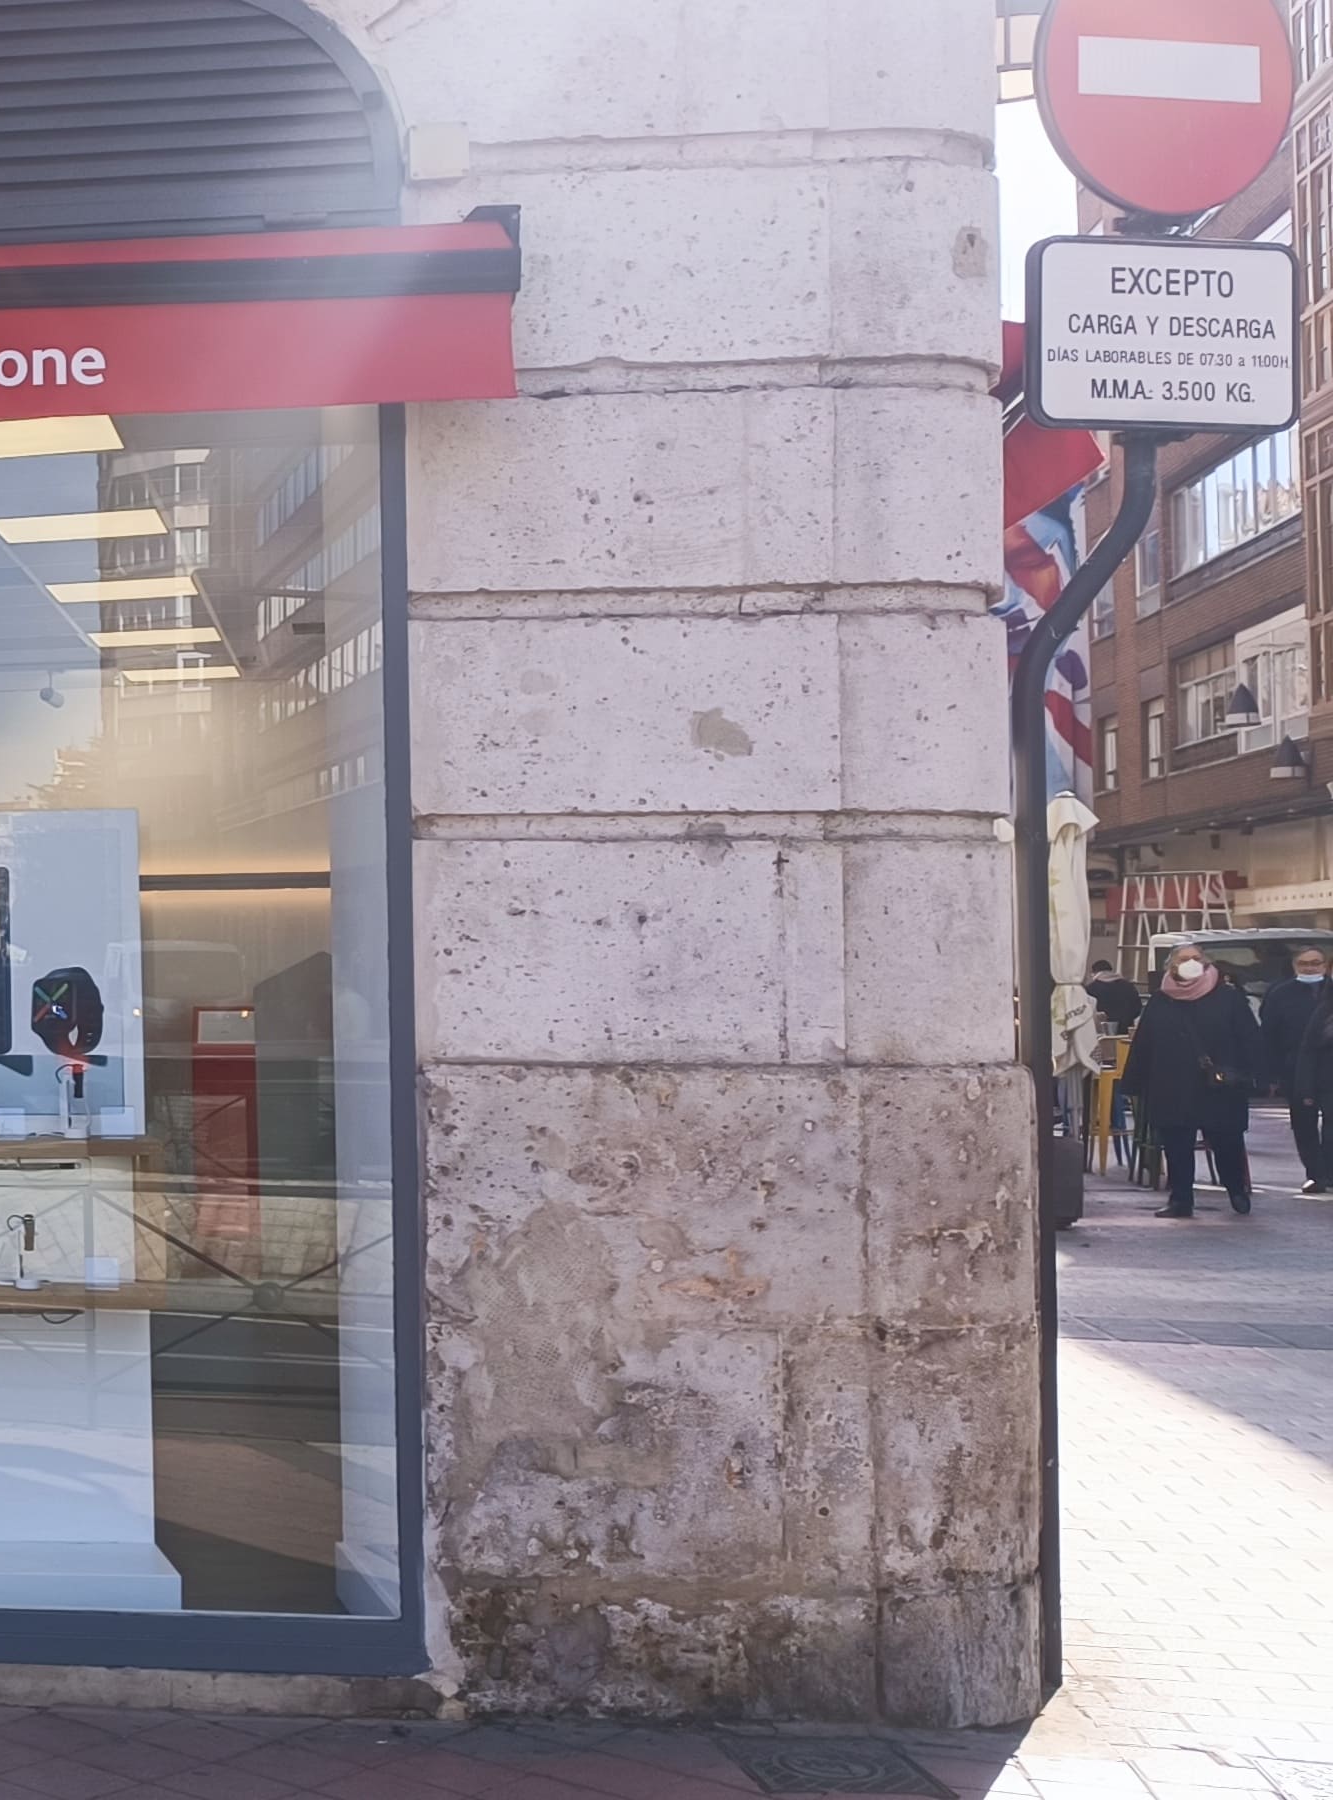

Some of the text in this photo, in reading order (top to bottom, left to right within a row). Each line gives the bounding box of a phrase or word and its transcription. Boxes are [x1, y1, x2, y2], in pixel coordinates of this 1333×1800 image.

[1110, 266, 1235, 299] EXCEPTO
[1068, 313, 1277, 340] CARGA Y DESCARGA
[1047, 346, 1079, 363] DÍAS
[1085, 348, 1172, 365] LABORABLES
[1178, 352, 1194, 366] DE
[1238, 356, 1246, 367] a
[1162, 380, 1216, 402] 3.500
[1226, 382, 1256, 403] KG.
